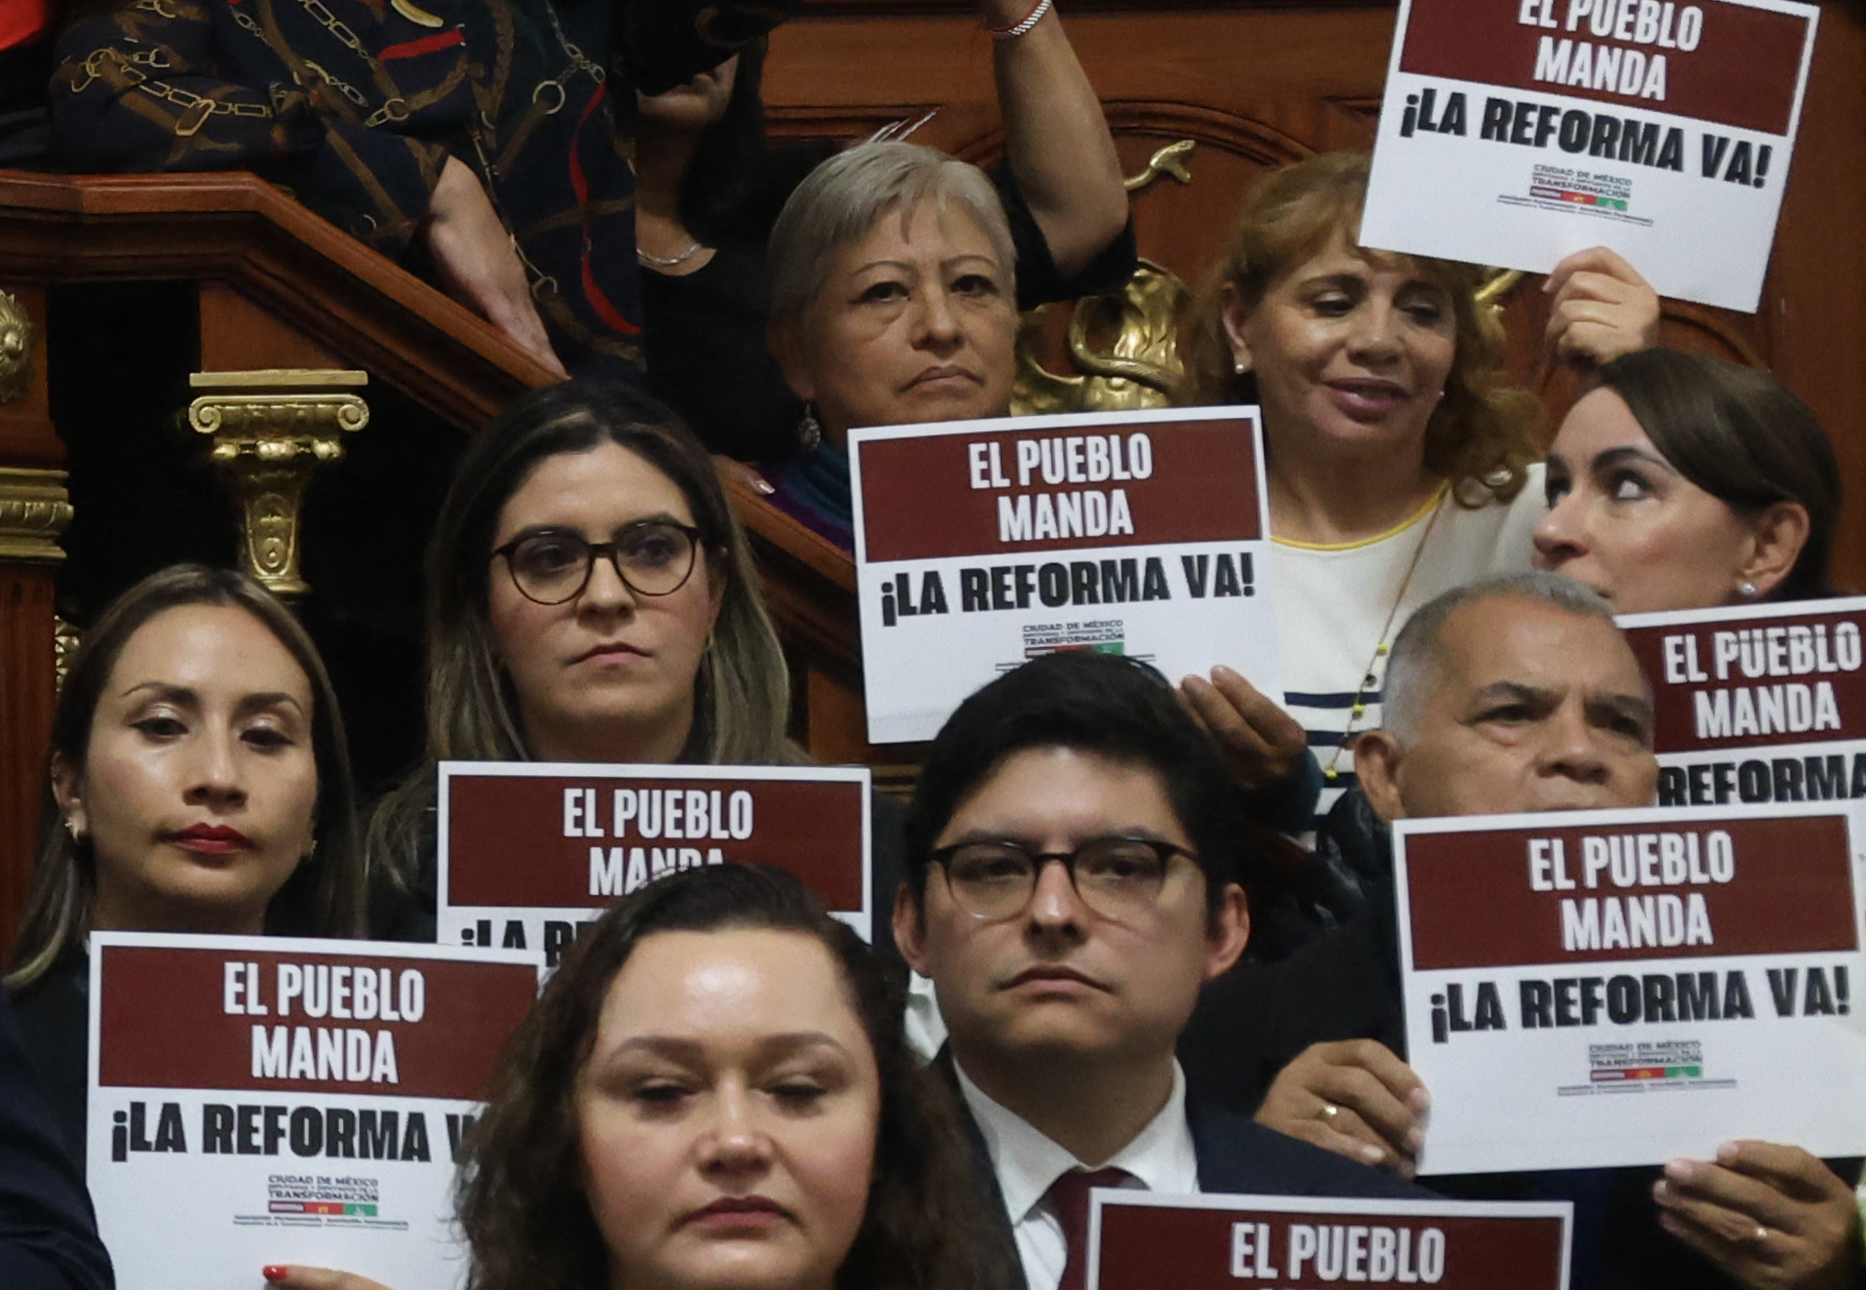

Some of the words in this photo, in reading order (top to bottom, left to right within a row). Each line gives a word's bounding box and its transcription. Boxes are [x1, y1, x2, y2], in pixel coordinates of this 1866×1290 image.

[1534, 36, 1665, 100] MANDA
[1401, 88, 1466, 137] ¡LA
[1481, 97, 1683, 171] REFORMA
[1702, 134, 1772, 188] VA!
[969, 442, 1010, 488] EL
[1018, 433, 1152, 485] PUEBLO
[998, 489, 1133, 541] MANDA
[882, 571, 948, 626] ¡LA
[960, 557, 1170, 612] REFORMA
[1181, 553, 1254, 598] VA!
[225, 962, 267, 1014] EL
[278, 964, 424, 1022] PUEBLO
[252, 1025, 398, 1083] MANDA
[112, 1102, 186, 1162] ¡LA
[203, 1104, 430, 1162] REFORMA
